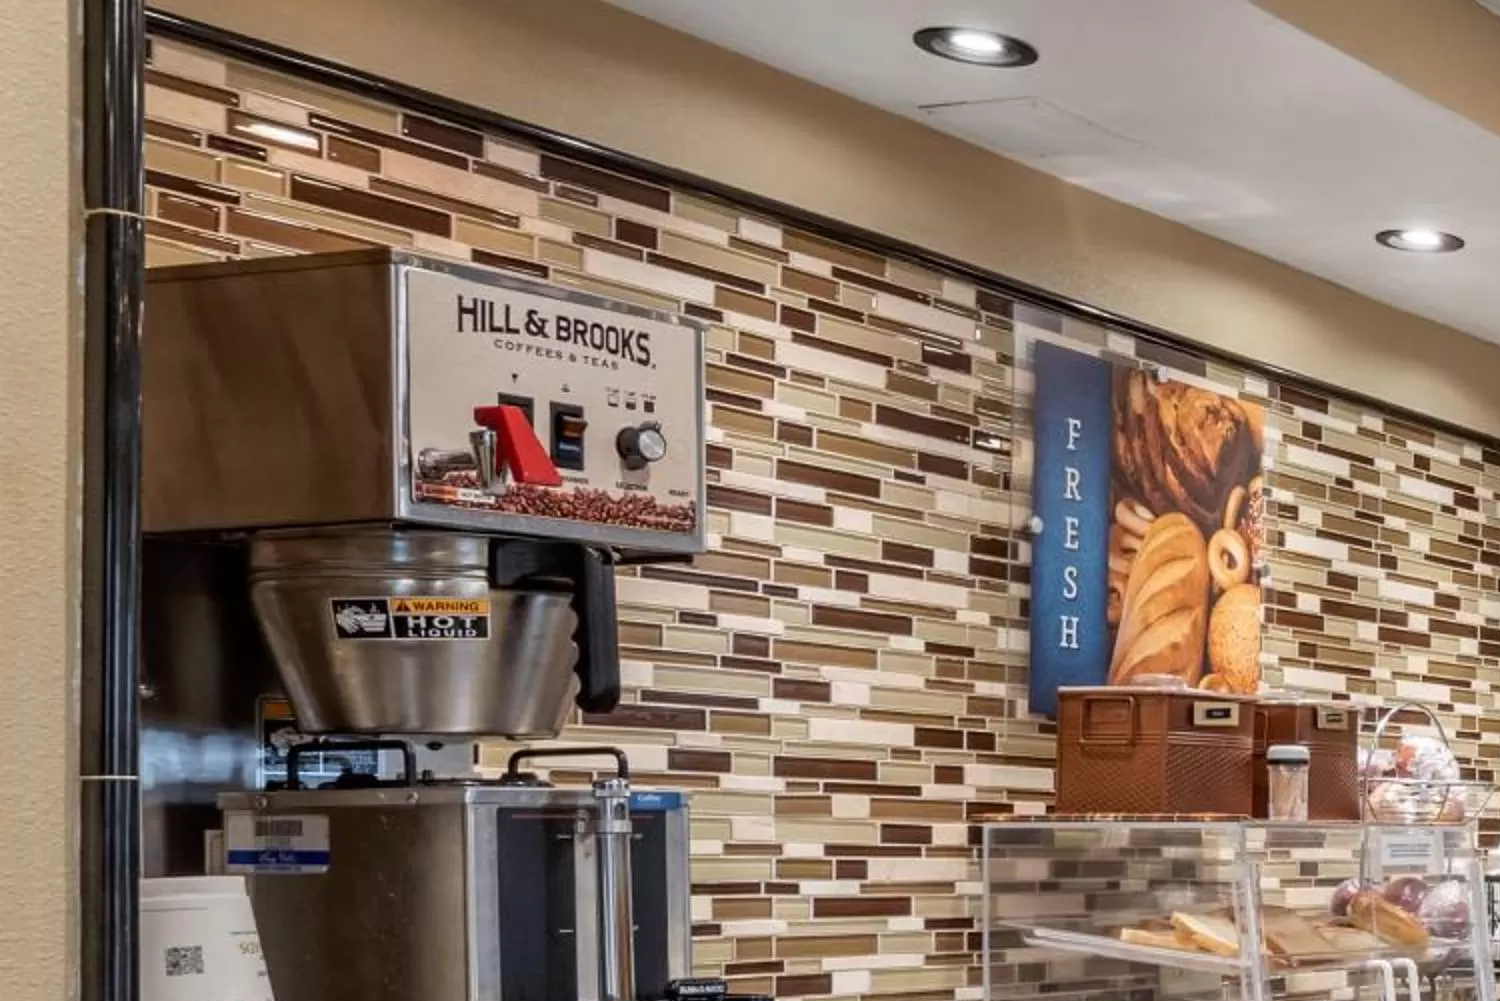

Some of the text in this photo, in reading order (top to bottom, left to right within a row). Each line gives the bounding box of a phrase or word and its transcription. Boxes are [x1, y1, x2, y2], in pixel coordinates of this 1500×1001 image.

[456, 295, 652, 367] HILL & BROOKS
[493, 339, 620, 371] COFFEES & TEAS
[1059, 417, 1083, 651] FRESH
[414, 601, 480, 612] WARNING
[407, 615, 477, 629] HOT
[408, 629, 478, 638] LIQUID
